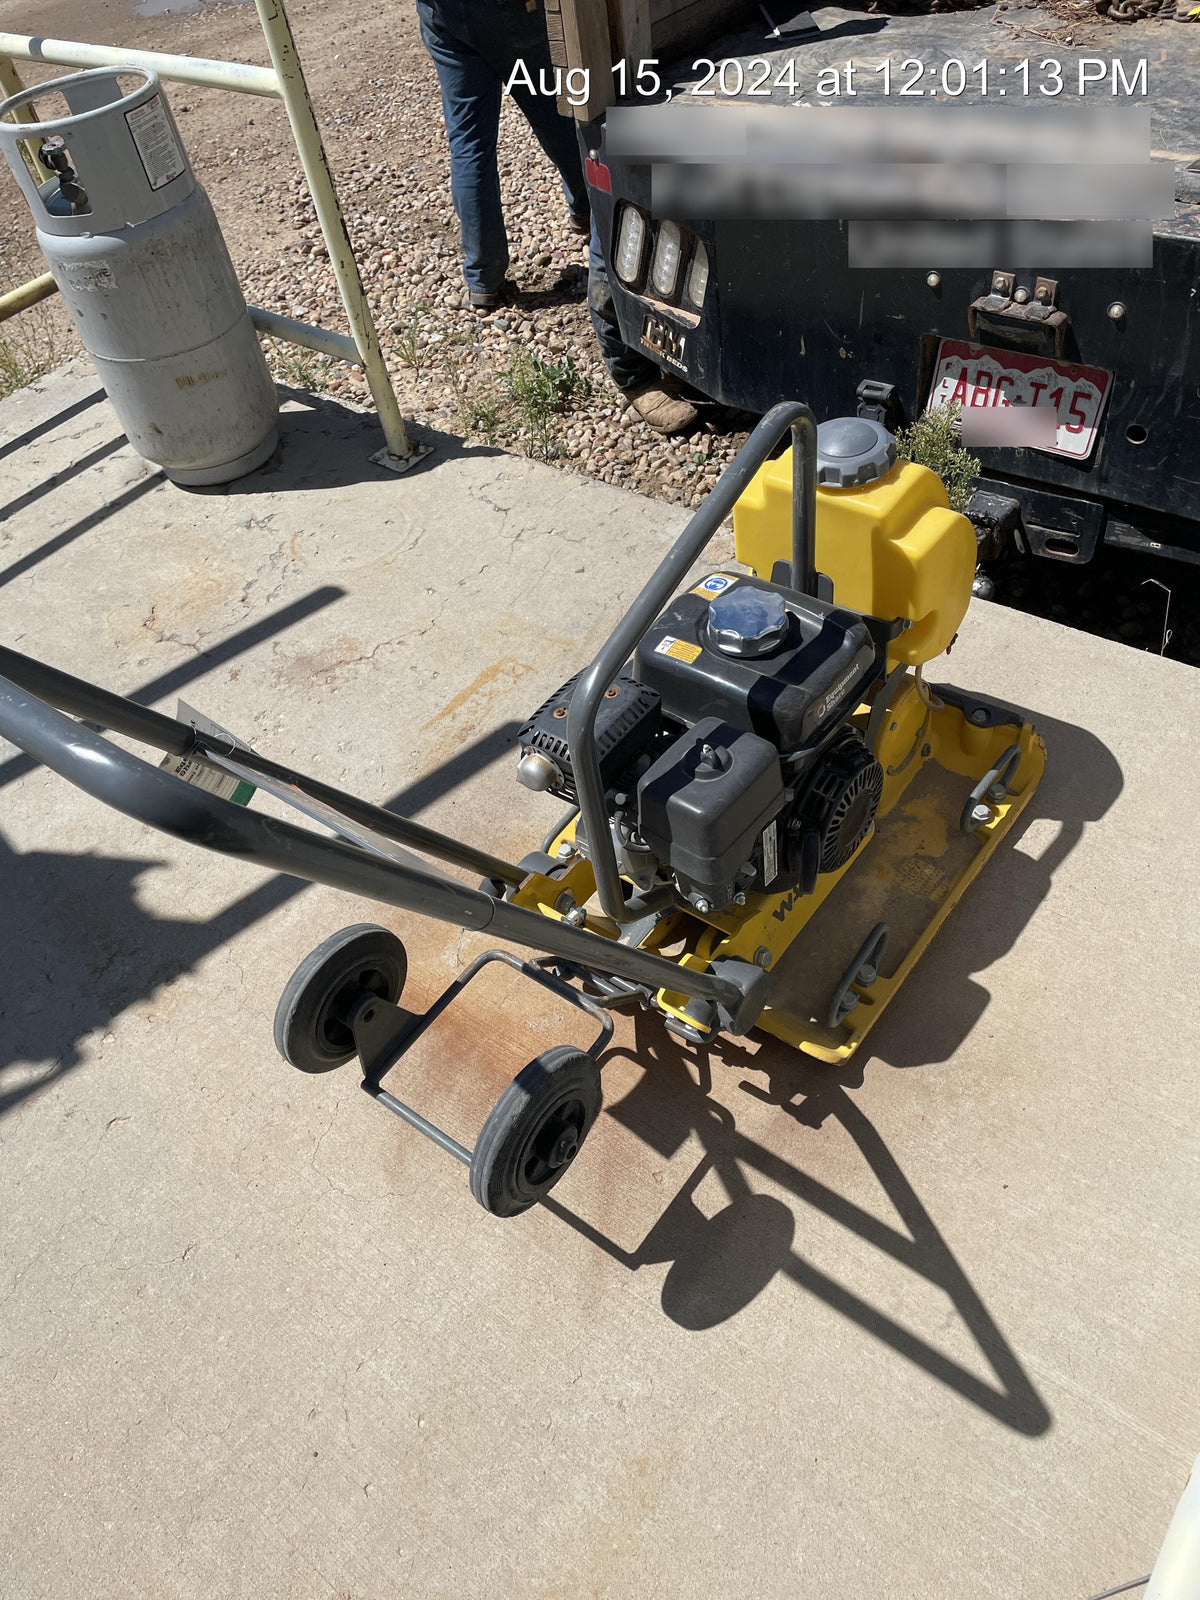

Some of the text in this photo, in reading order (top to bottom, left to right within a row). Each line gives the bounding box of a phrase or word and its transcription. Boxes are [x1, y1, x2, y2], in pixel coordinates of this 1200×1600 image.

[640, 337, 688, 373] TRUCK BEDS
[826, 663, 860, 704] Equipment
[826, 688, 846, 712] Share
